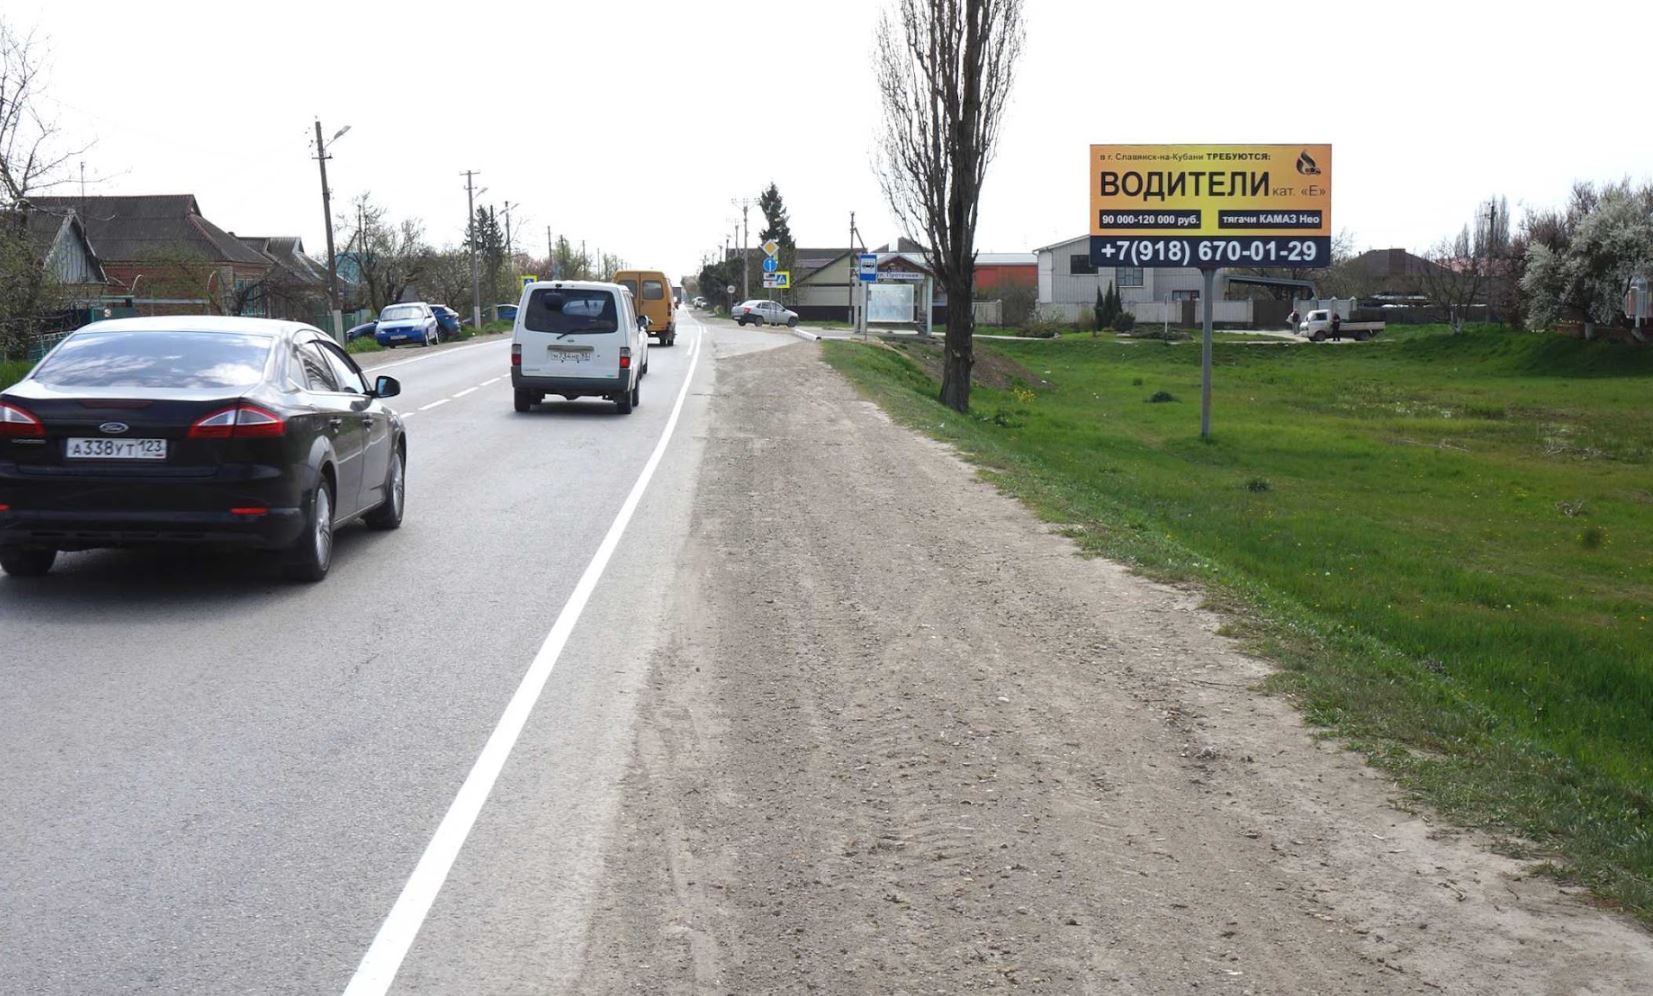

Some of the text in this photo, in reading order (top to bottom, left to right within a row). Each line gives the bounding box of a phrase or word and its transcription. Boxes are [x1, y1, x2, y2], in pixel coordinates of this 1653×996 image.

[1115, 153, 1204, 162] Славянск-на-Кубани
[1101, 171, 1269, 202] ВОДИТЕЛИ
[1272, 187, 1296, 197] кат.
[1102, 215, 1199, 226] 90 000-120 000 руб.
[1223, 214, 1320, 224] тягачи КАМАЗ Нео
[1101, 240, 1317, 265] +7(918) 670-01-29
